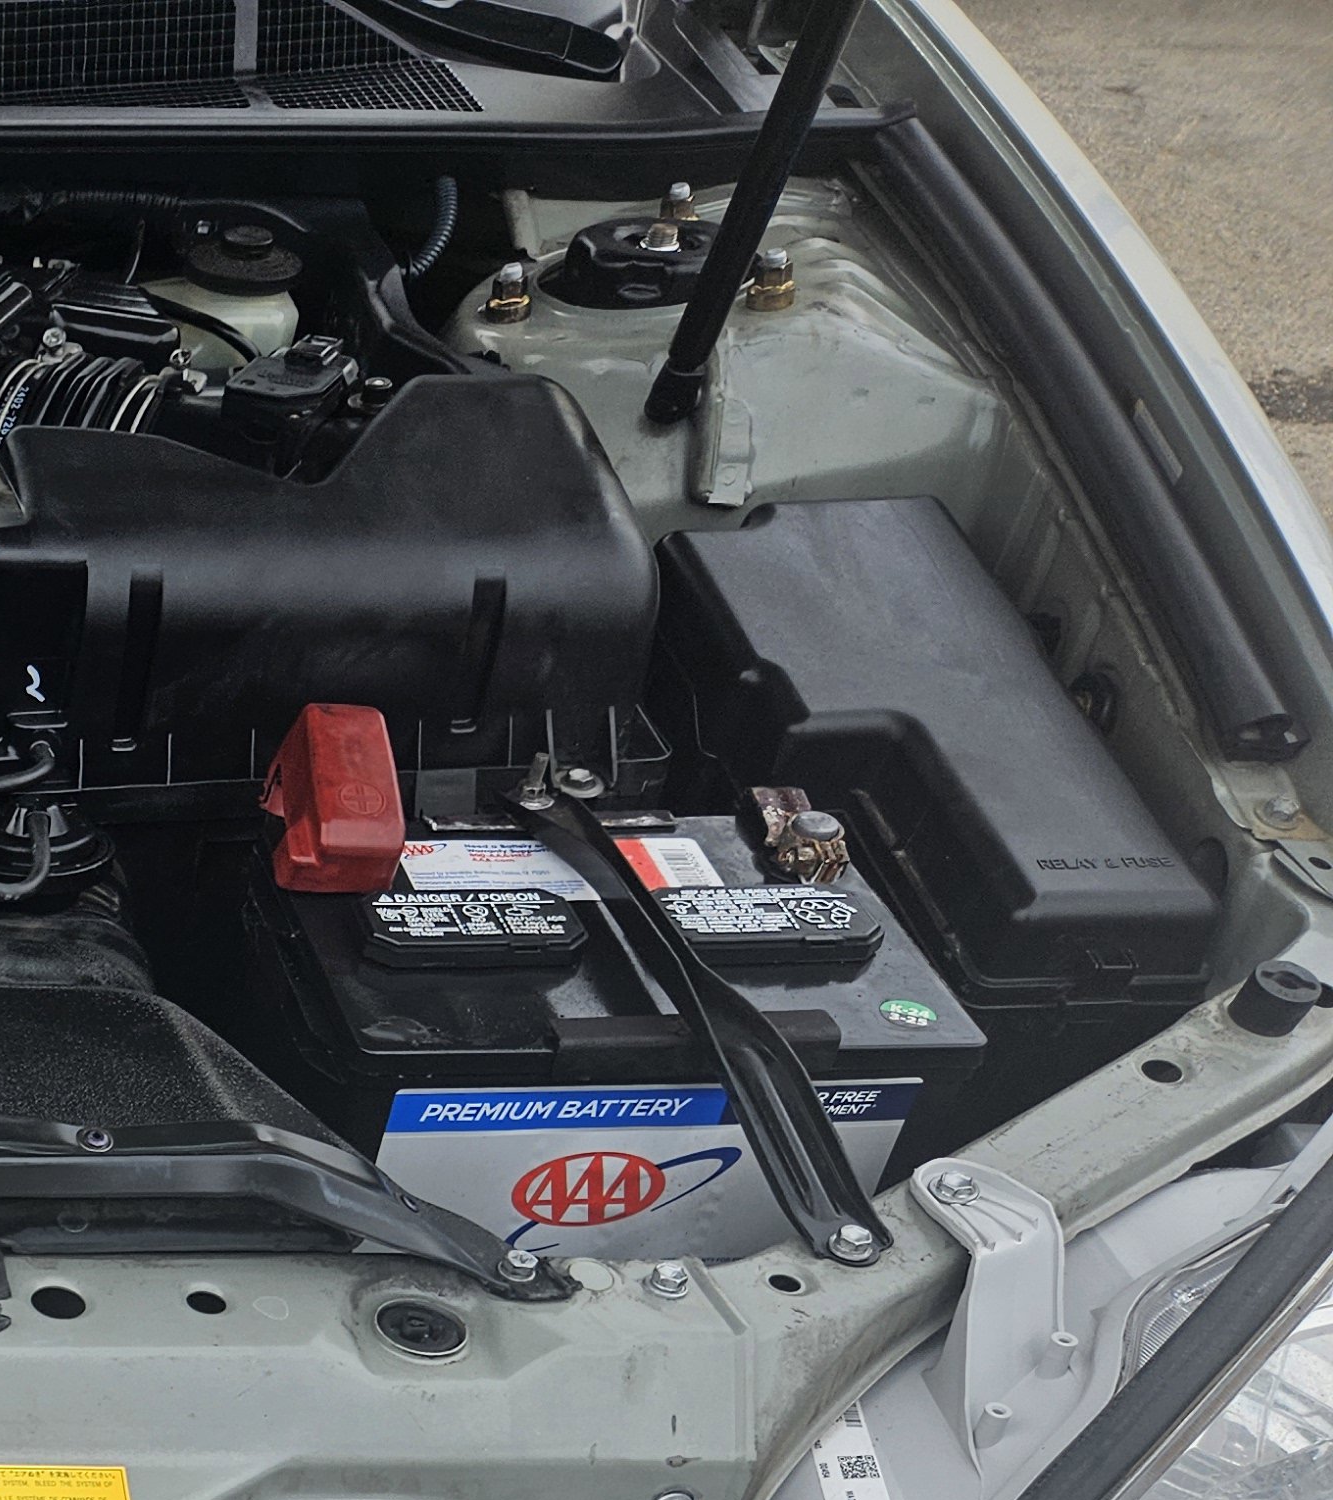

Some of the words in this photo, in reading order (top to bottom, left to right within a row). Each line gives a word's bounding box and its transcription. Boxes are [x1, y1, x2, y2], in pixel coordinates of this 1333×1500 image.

[1037, 858, 1099, 871] RELAY
[1121, 856, 1174, 869] FUSE
[394, 893, 463, 903] DANGER
[465, 893, 474, 902] /
[478, 892, 541, 902] POISON
[830, 1089, 882, 1104] FREE
[418, 1100, 560, 1124] PREMIUM
[556, 1096, 693, 1119] BATTERY
[525, 1153, 658, 1226] AAA
